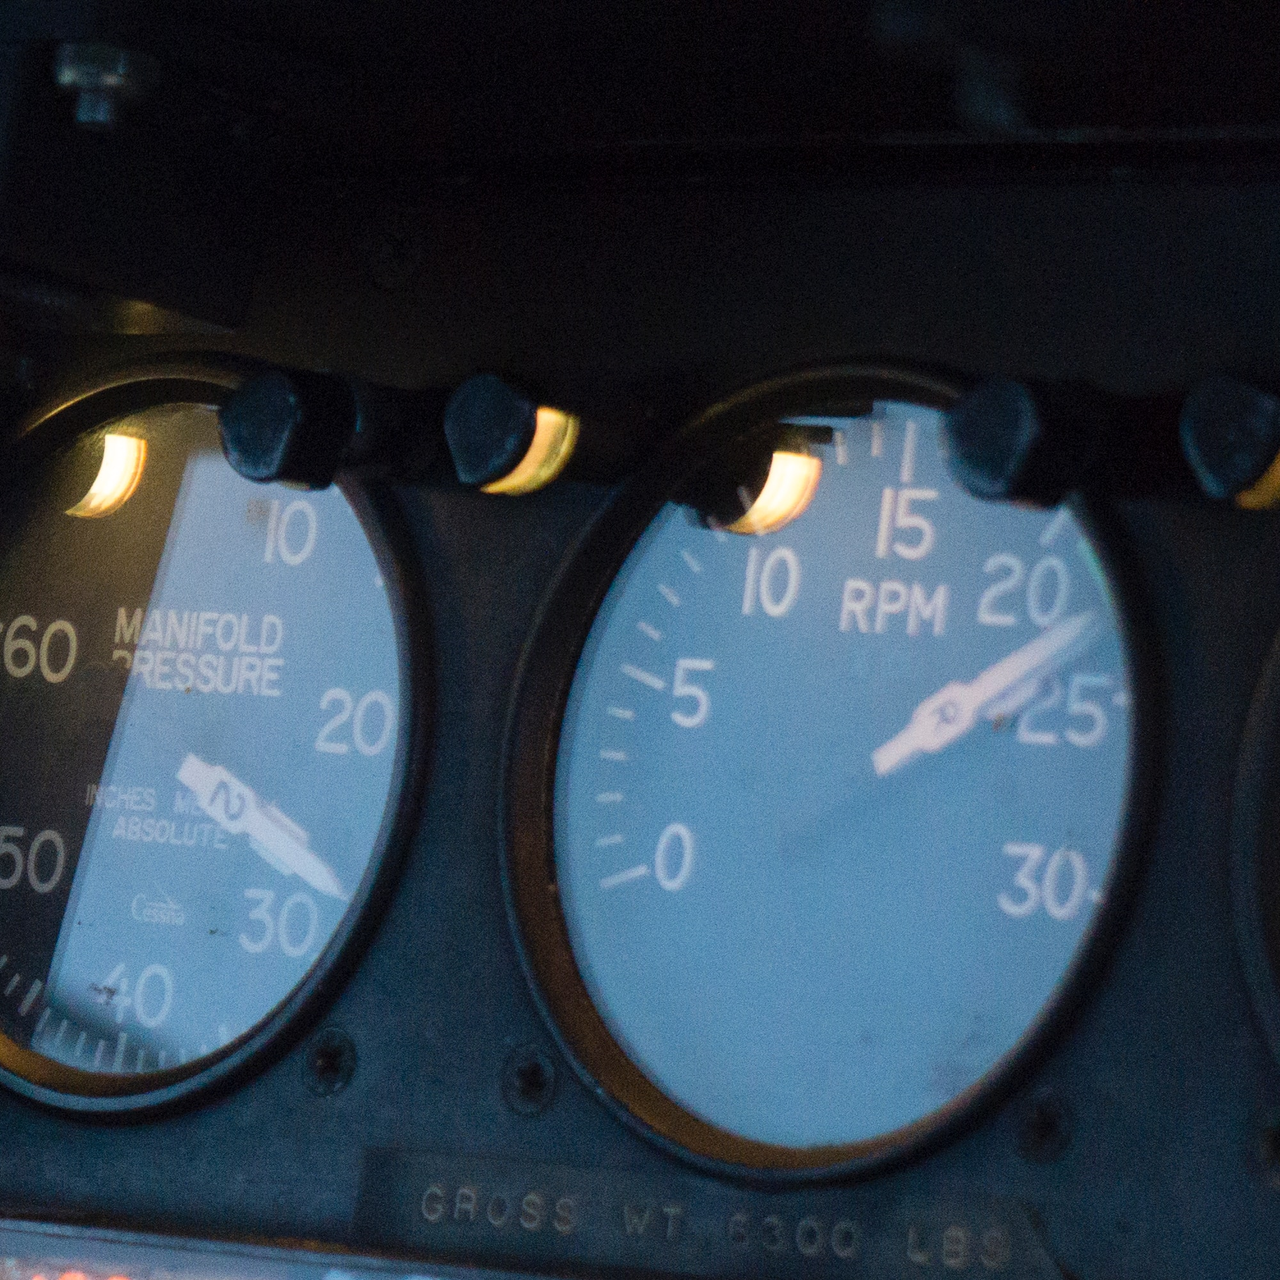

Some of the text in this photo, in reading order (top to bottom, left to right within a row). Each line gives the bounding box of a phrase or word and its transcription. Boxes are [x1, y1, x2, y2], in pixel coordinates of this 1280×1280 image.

[263, 498, 318, 567] 10
[875, 487, 939, 561] 15
[741, 546, 802, 618] 10
[839, 579, 950, 636] RPM
[976, 553, 1072, 626] 20
[1, 614, 78, 684] 60
[113, 607, 285, 655] MANIFOLD
[112, 650, 285, 698] PRESSURE
[670, 658, 715, 728] 5
[314, 688, 396, 757] 20
[112, 815, 228, 850] ABSOLUTE
[653, 822, 694, 892] 0
[996, 842, 1088, 922] 30
[239, 888, 319, 958] 30
[97, 961, 174, 1029] 40
[418, 1185, 577, 1236] GROSS
[622, 1204, 684, 1243] WT
[905, 1223, 1013, 1269] LBS
